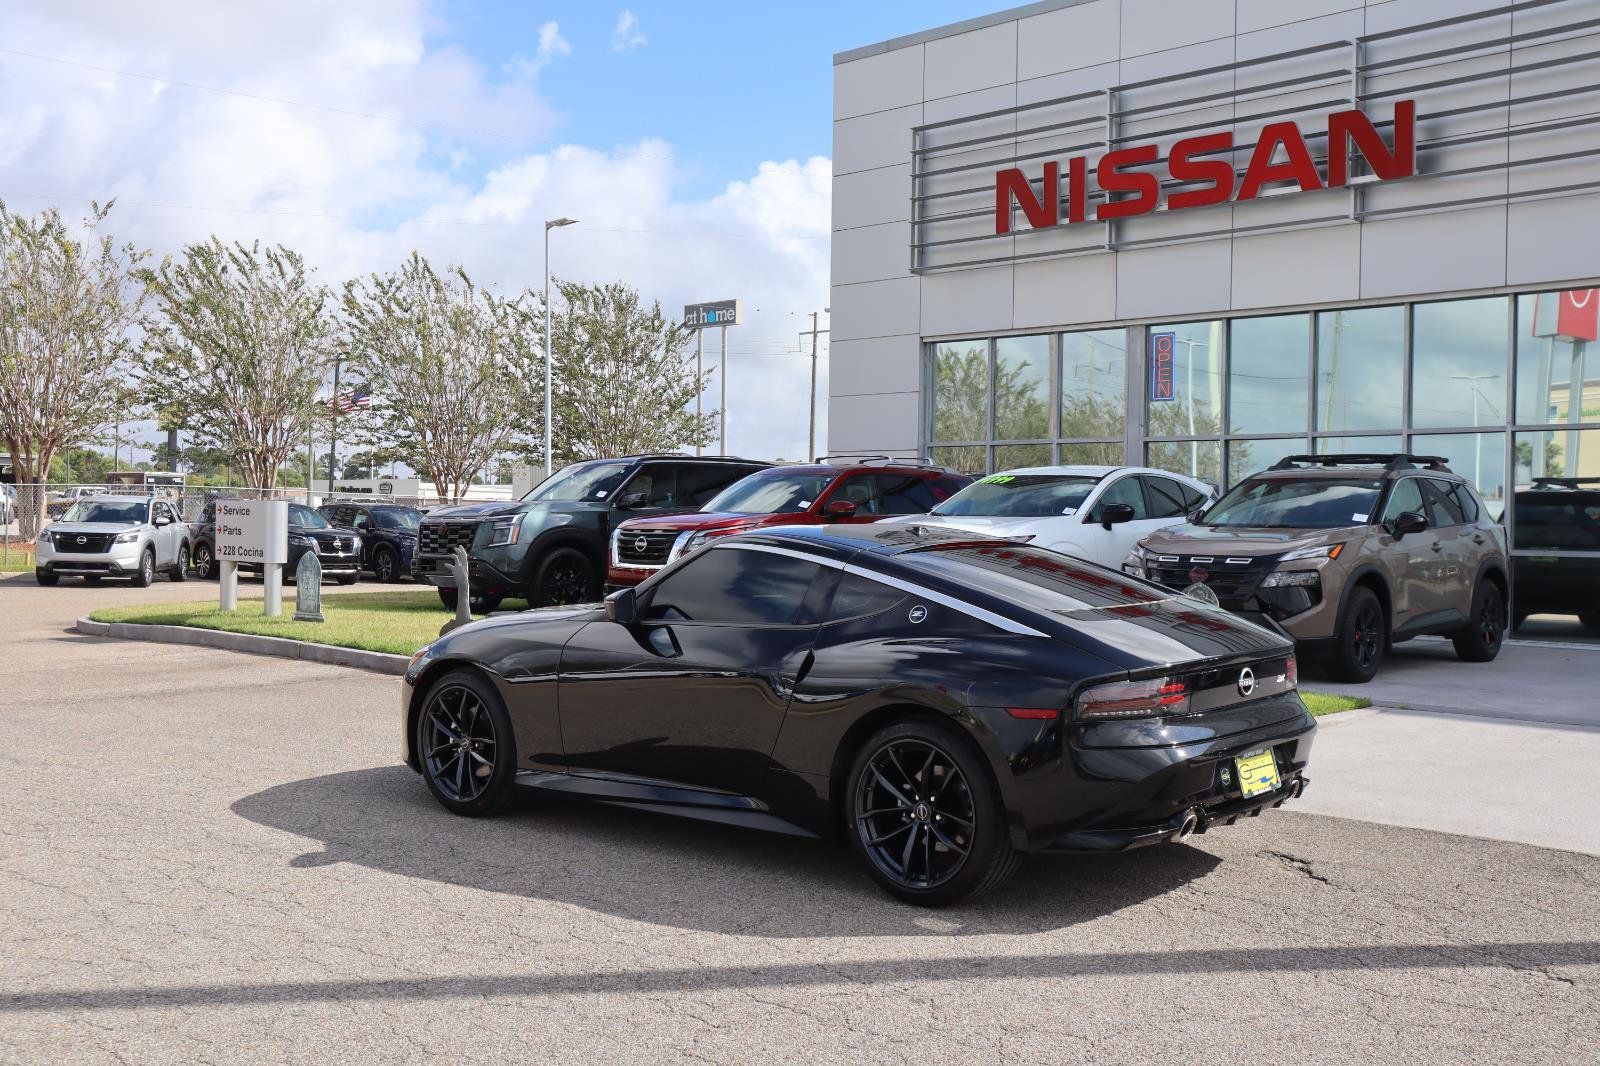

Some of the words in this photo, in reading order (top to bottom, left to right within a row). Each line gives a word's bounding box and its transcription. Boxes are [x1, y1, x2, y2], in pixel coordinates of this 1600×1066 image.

[995, 99, 1416, 236] NISSAN
[1158, 337, 1172, 398] OPEN
[223, 504, 251, 516] Service
[223, 525, 242, 536] Parts
[223, 545, 236, 556] 228
[237, 546, 264, 558] Cocina
